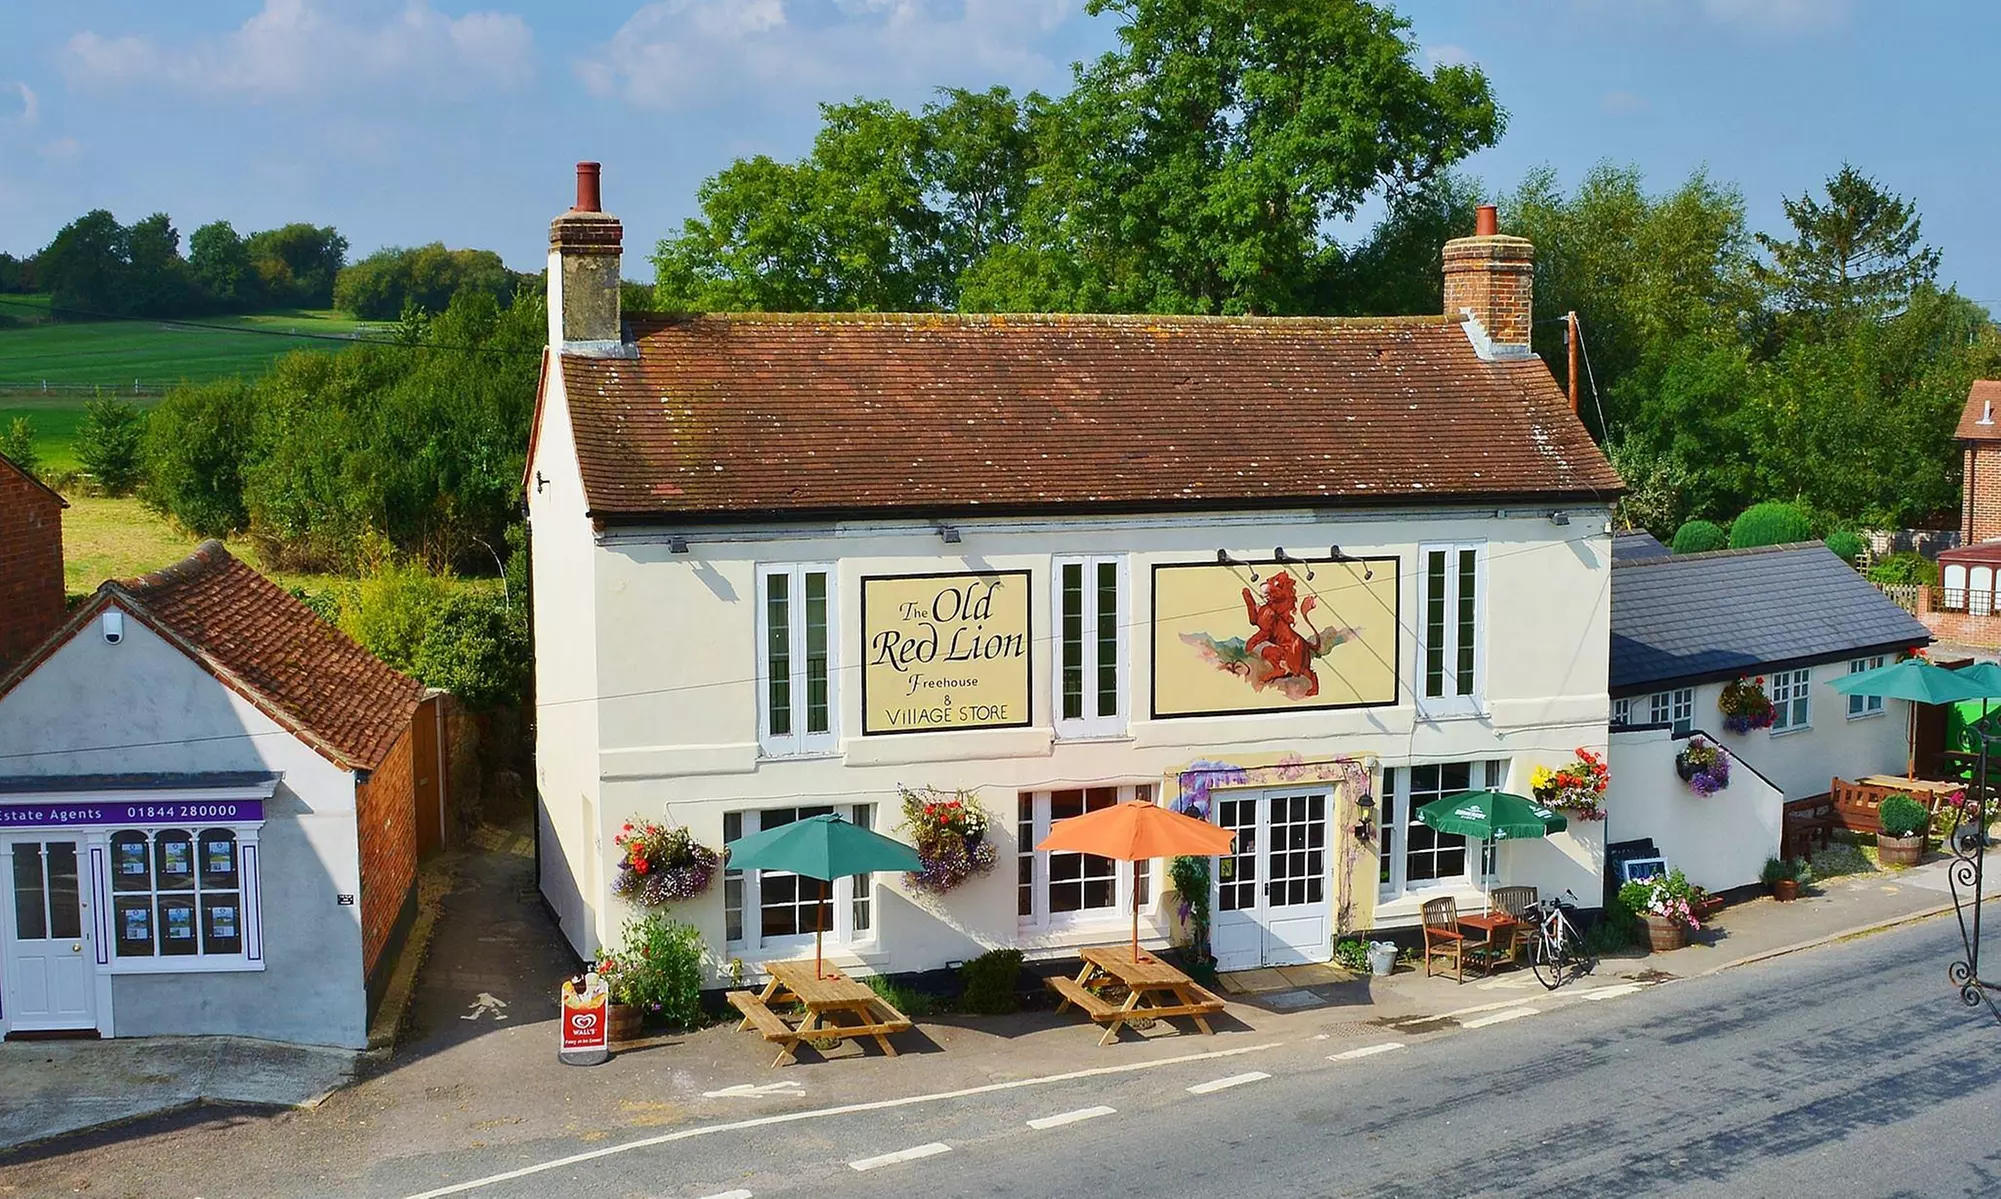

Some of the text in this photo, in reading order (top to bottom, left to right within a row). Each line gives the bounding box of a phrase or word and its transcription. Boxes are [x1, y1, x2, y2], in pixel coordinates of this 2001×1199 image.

[899, 580, 1001, 623] The Old
[871, 622, 1026, 672] Red Lion
[906, 673, 979, 697] Freehouse
[959, 704, 1009, 722] STORE
[50, 809, 102, 822] Agents
[127, 806, 174, 818] 01844
[180, 804, 237, 817] 280000
